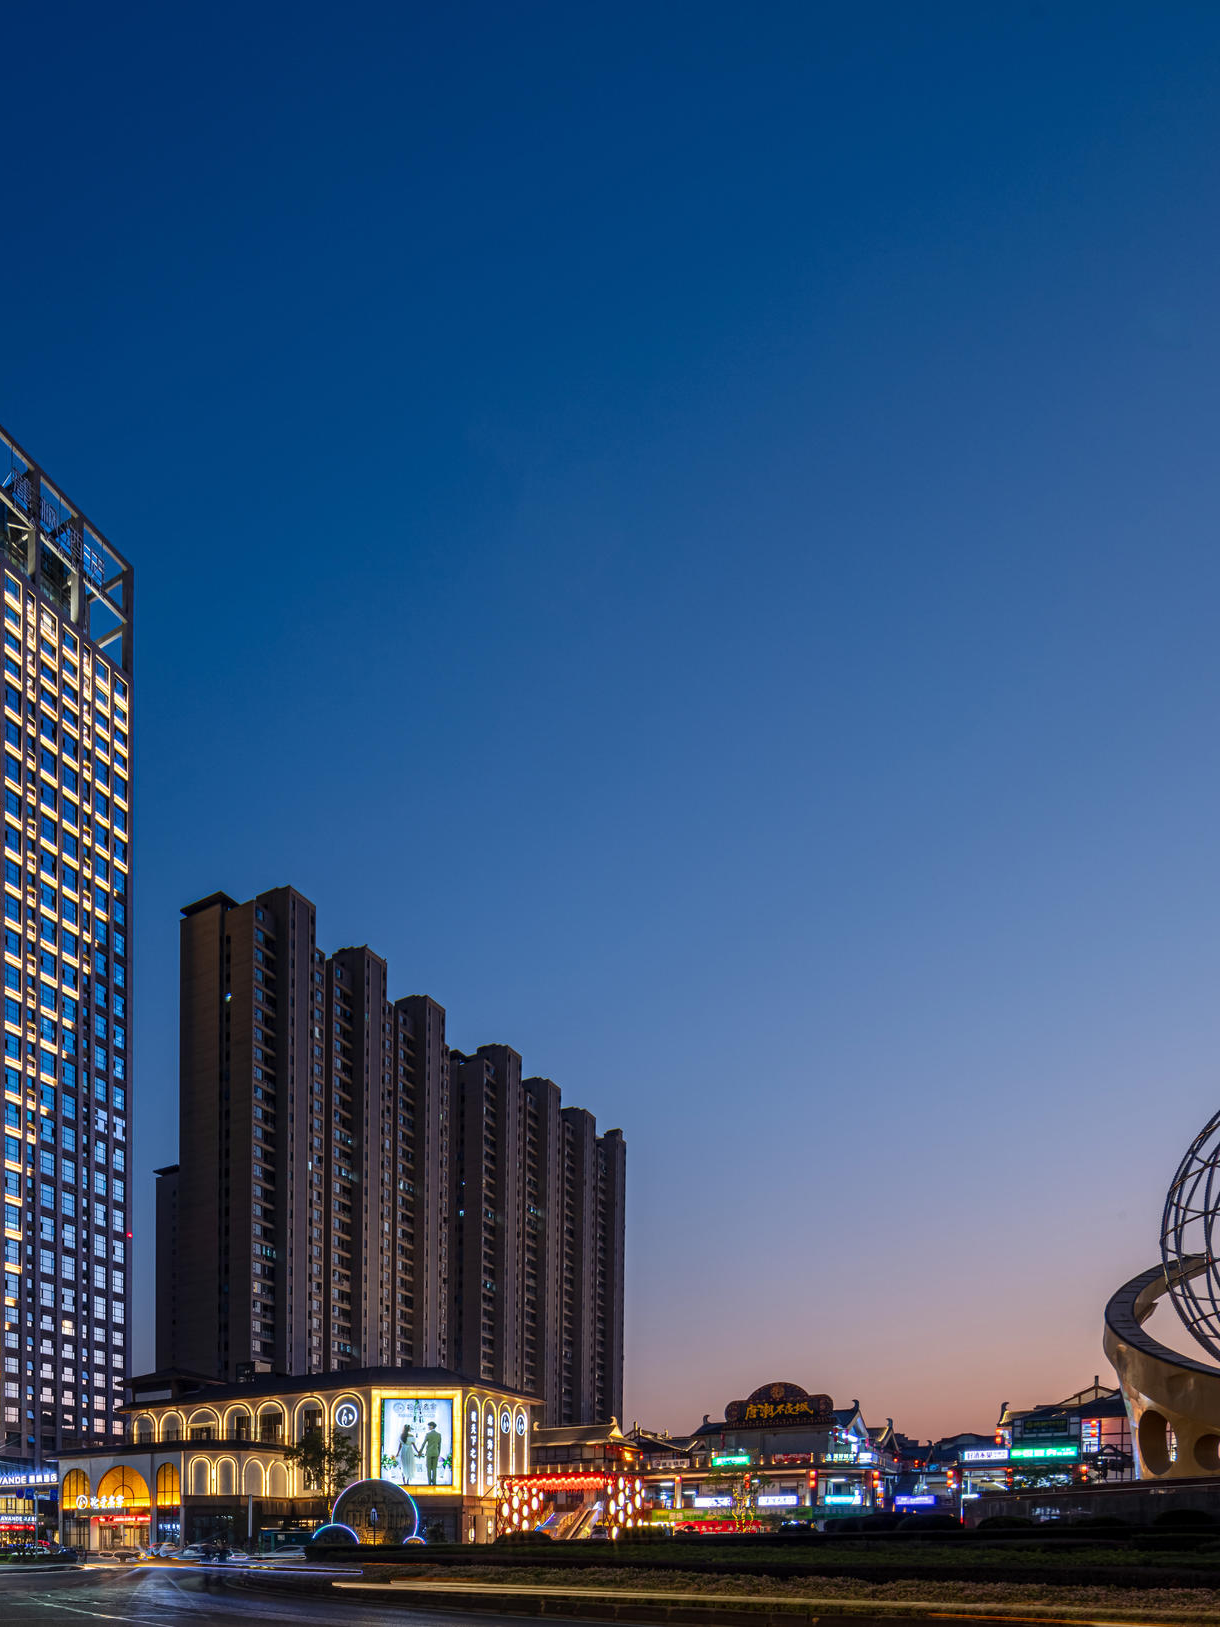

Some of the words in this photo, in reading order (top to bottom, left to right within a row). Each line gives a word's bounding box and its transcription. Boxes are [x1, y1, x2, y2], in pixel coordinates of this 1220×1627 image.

[745, 1402, 814, 1421] 唐潮不夜城
